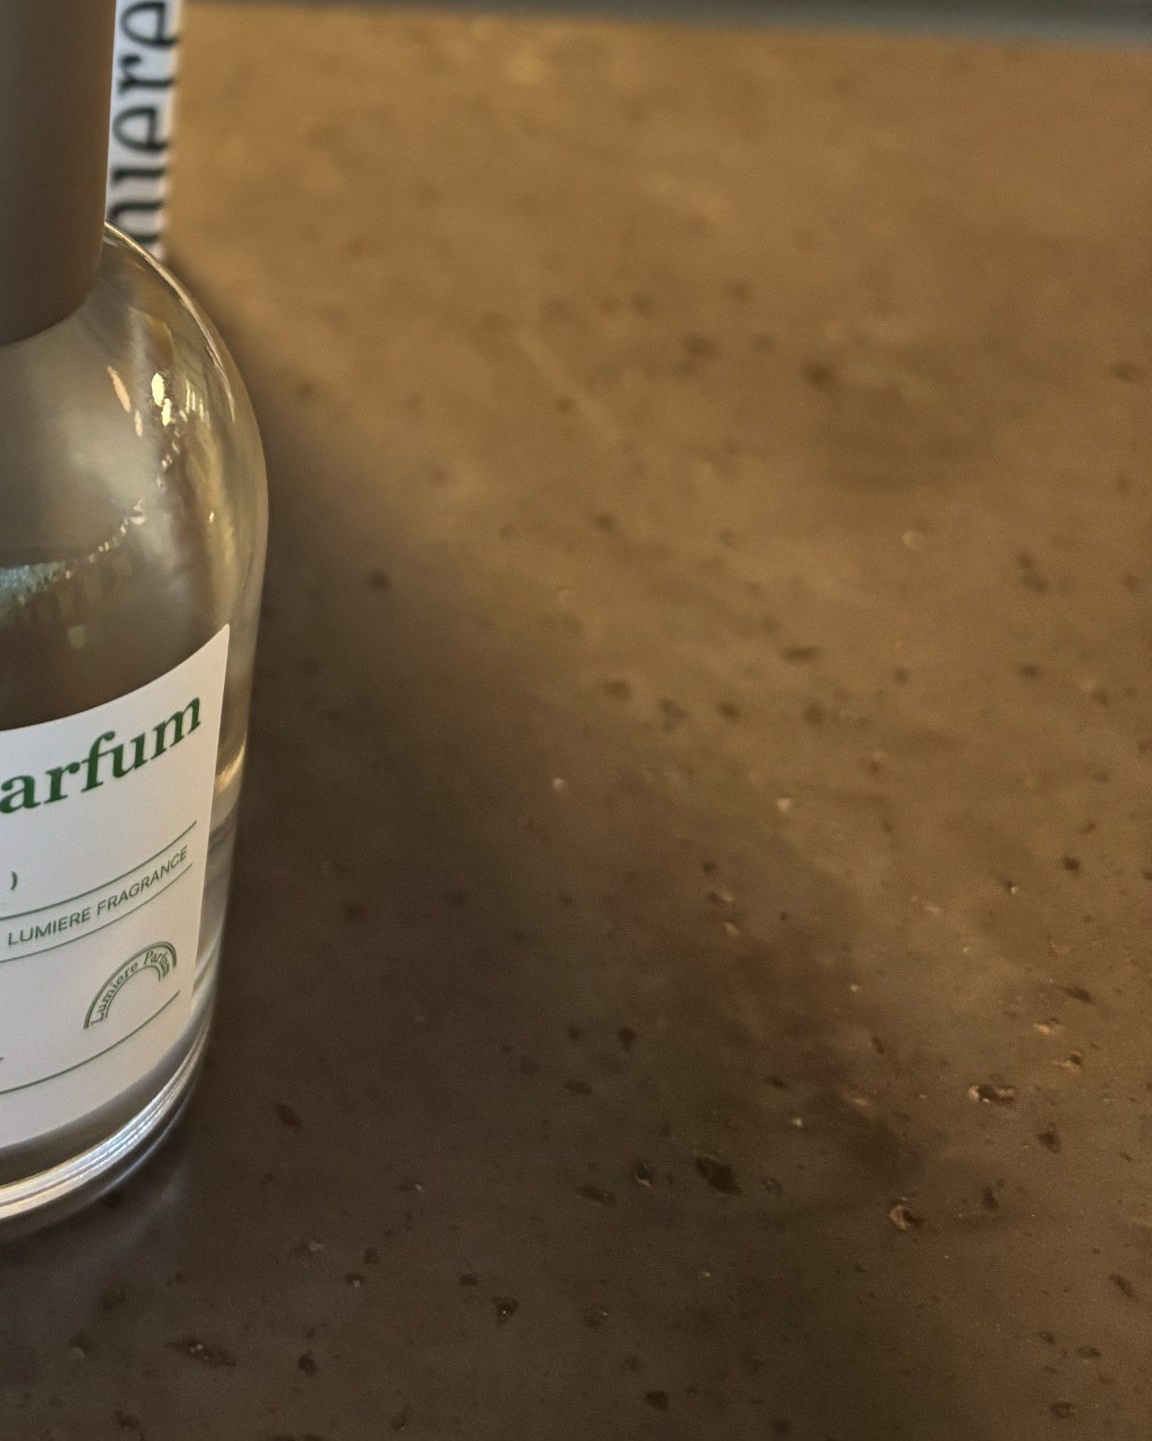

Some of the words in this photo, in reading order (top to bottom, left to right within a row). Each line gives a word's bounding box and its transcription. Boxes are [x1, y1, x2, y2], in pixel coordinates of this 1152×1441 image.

[7, 906, 92, 947] LUMIERE
[96, 844, 189, 916] FRAGRANCE
[90, 961, 139, 1025] Lumiere
